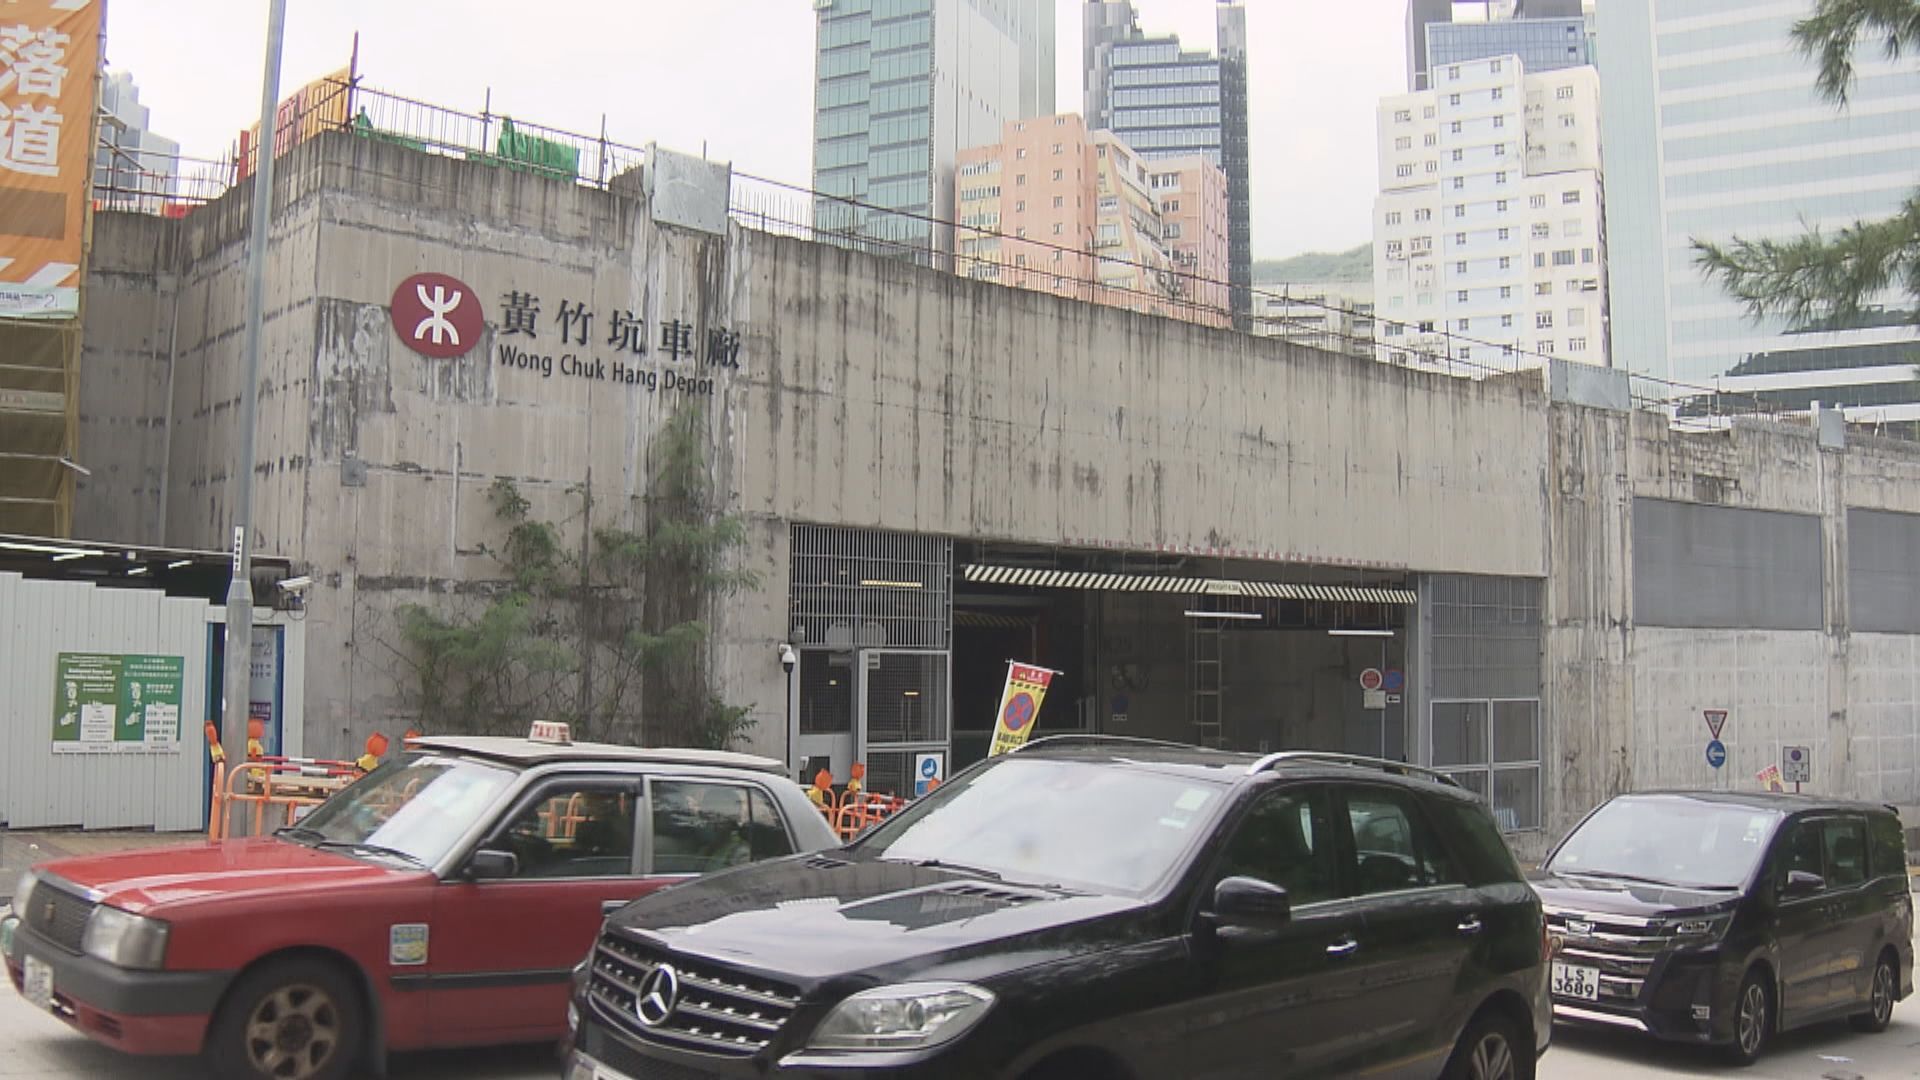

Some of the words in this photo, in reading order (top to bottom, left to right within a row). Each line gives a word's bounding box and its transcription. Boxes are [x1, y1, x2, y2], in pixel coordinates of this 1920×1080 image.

[500, 344, 553, 376] Wong
[560, 353, 605, 381] Chuk
[612, 362, 657, 392] Hang
[664, 370, 715, 396] Depot
[1564, 965, 1585, 982] LS
[1554, 978, 1595, 998] 3689
